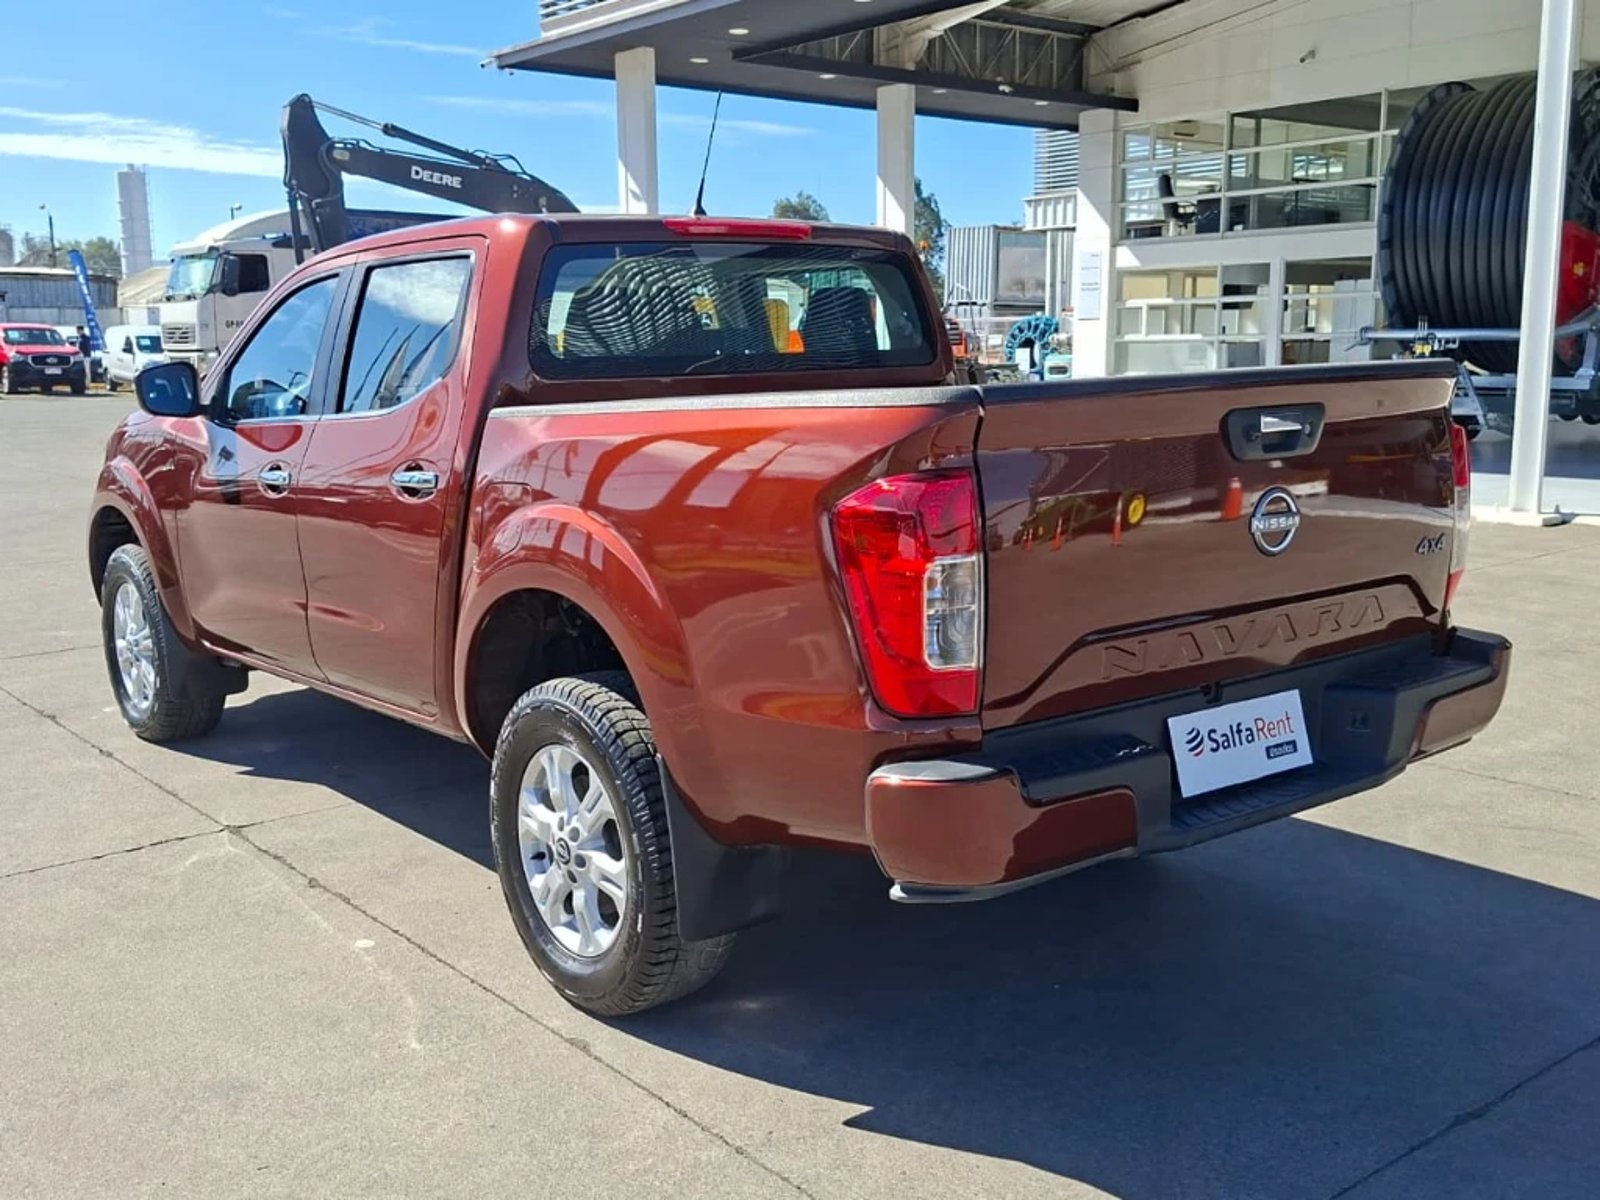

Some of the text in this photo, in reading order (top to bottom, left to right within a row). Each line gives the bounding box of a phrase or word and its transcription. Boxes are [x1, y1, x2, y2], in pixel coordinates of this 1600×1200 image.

[411, 165, 462, 188] DEERE
[1253, 515, 1299, 530] NISSAN
[1101, 594, 1385, 680] NAVARA
[1207, 711, 1295, 753] SalfaRent
